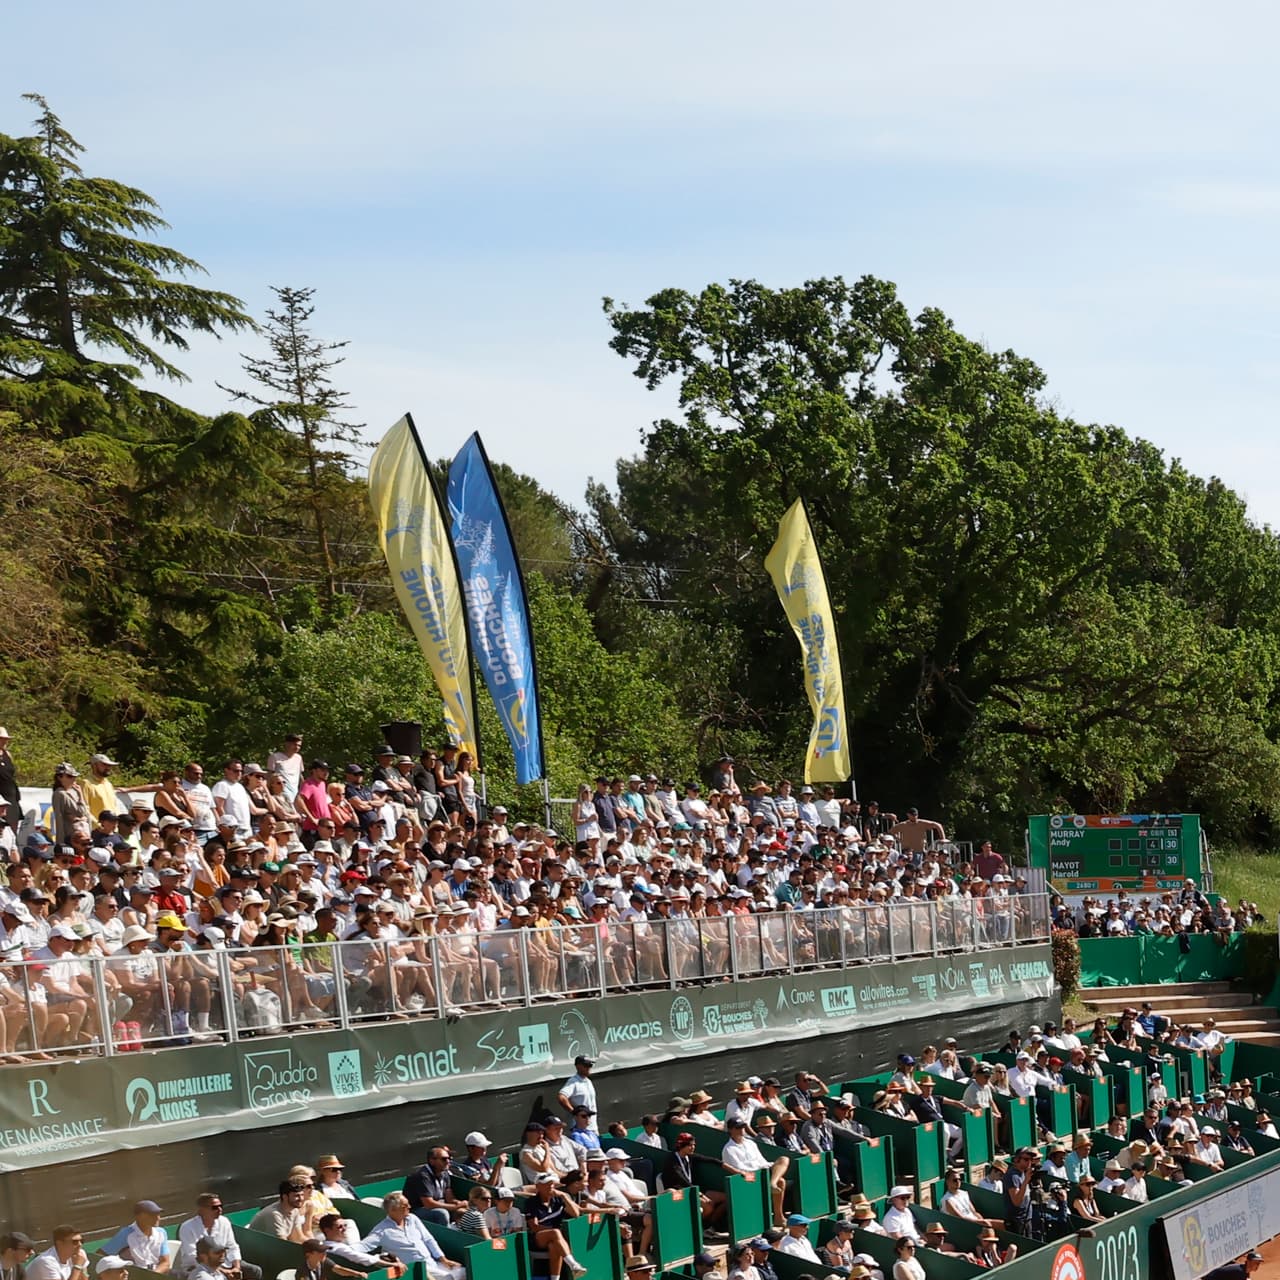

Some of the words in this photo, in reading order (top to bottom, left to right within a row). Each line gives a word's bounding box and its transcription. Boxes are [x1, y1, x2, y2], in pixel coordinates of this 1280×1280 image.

[1050, 830, 1085, 838] MURRAY
[1050, 838, 1070, 848] Andy
[1166, 840, 1177, 849] 30
[1166, 856, 1177, 865] 30
[1052, 870, 1080, 878] Harold
[828, 990, 849, 1008] RMC
[676, 1013, 689, 1029] VIP
[28, 1079, 62, 1117] R
[1208, 1210, 1248, 1242] BOUCHES
[1211, 1245, 1223, 1261] DU
